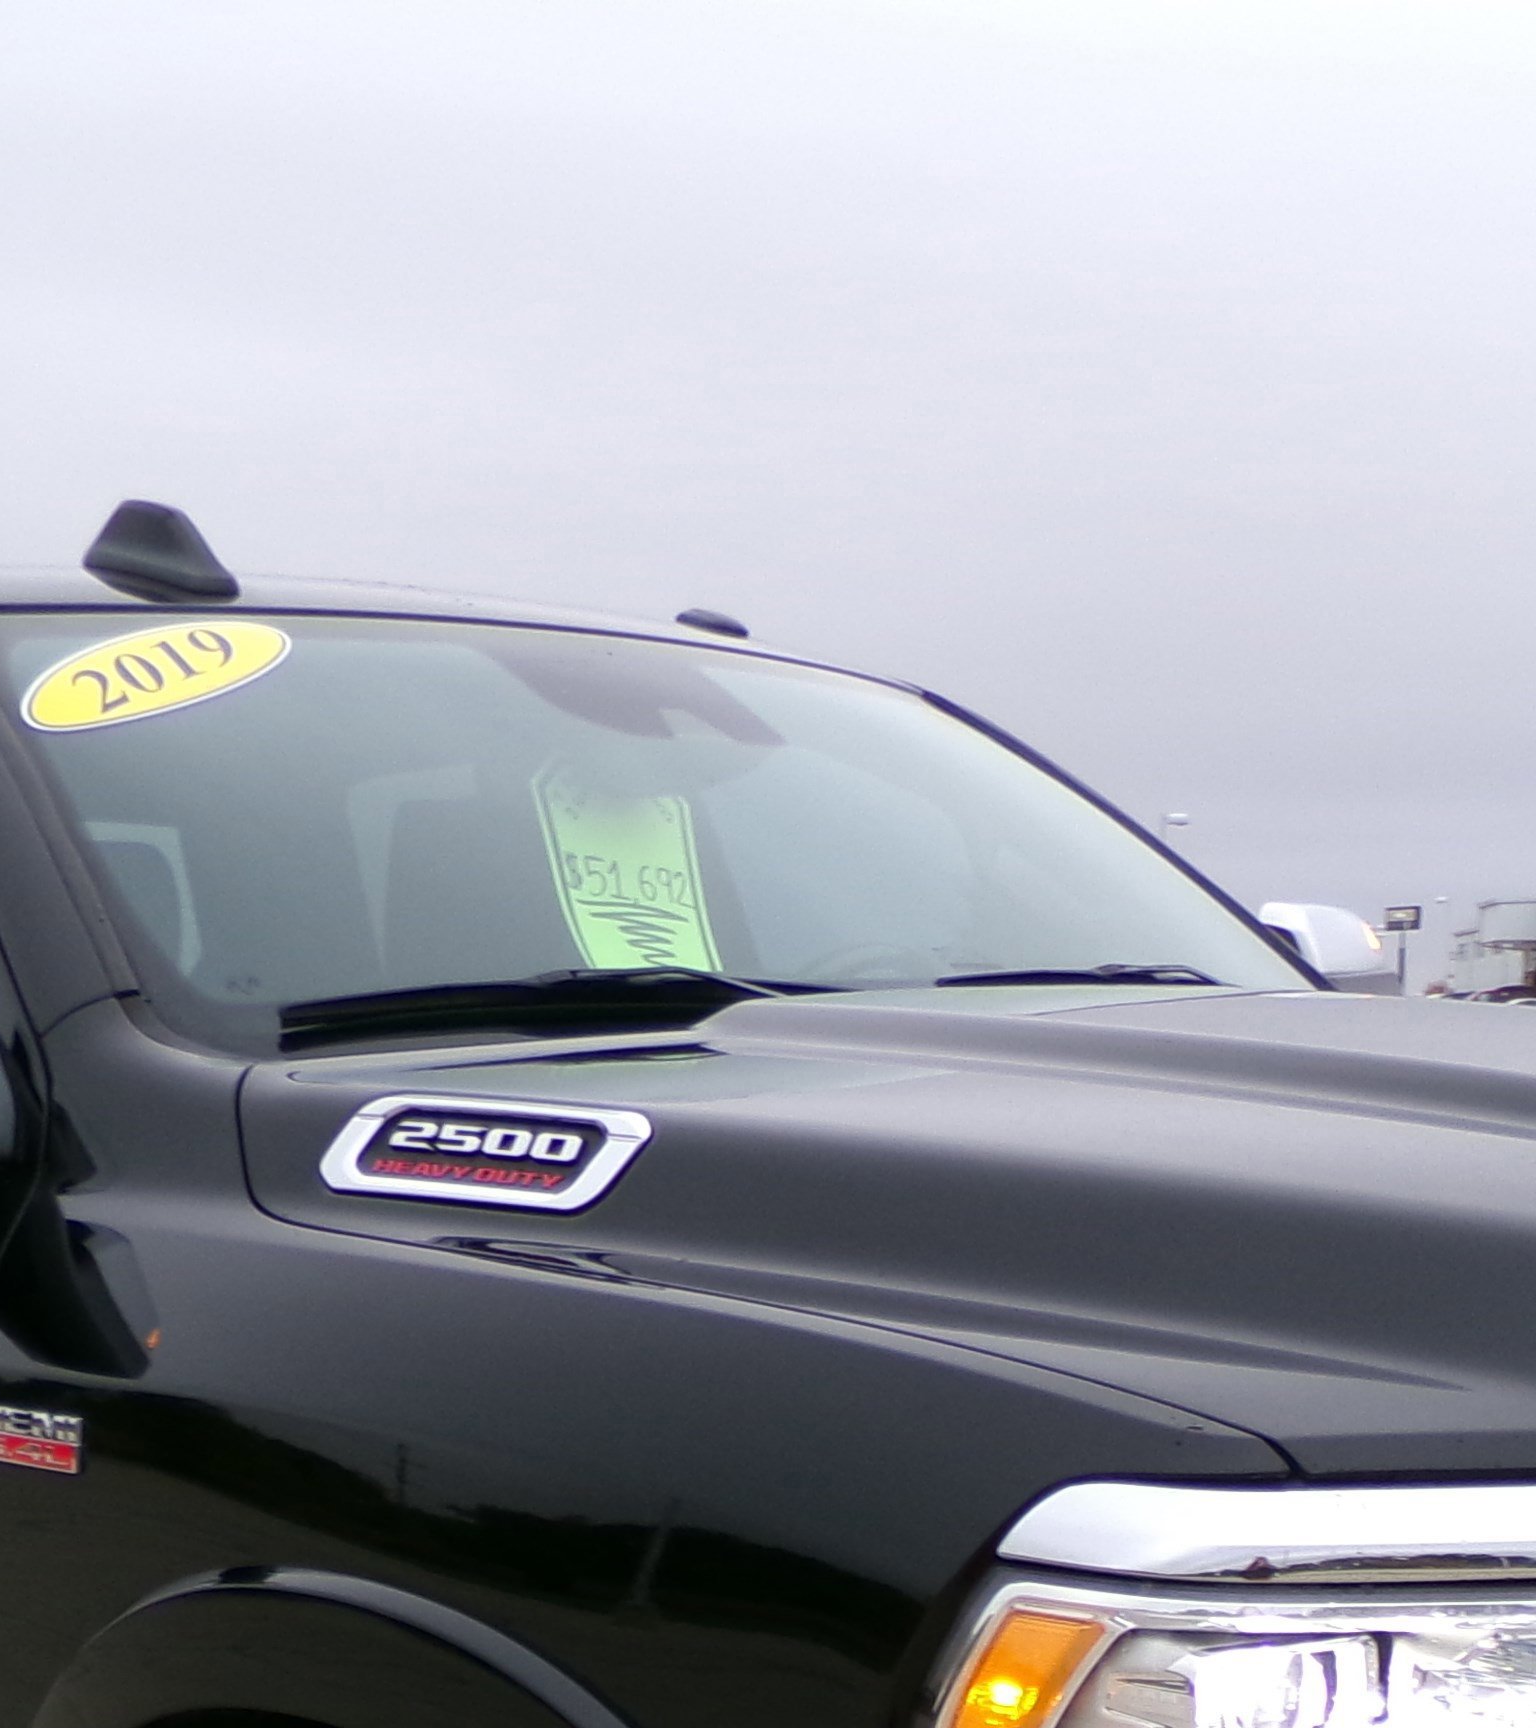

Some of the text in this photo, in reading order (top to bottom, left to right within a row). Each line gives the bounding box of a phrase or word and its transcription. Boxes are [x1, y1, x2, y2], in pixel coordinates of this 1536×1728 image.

[71, 628, 233, 714] 2019
[565, 853, 697, 909] $51,692
[387, 1120, 584, 1163] 2500
[372, 1158, 565, 1190] HEAVY DUTY
